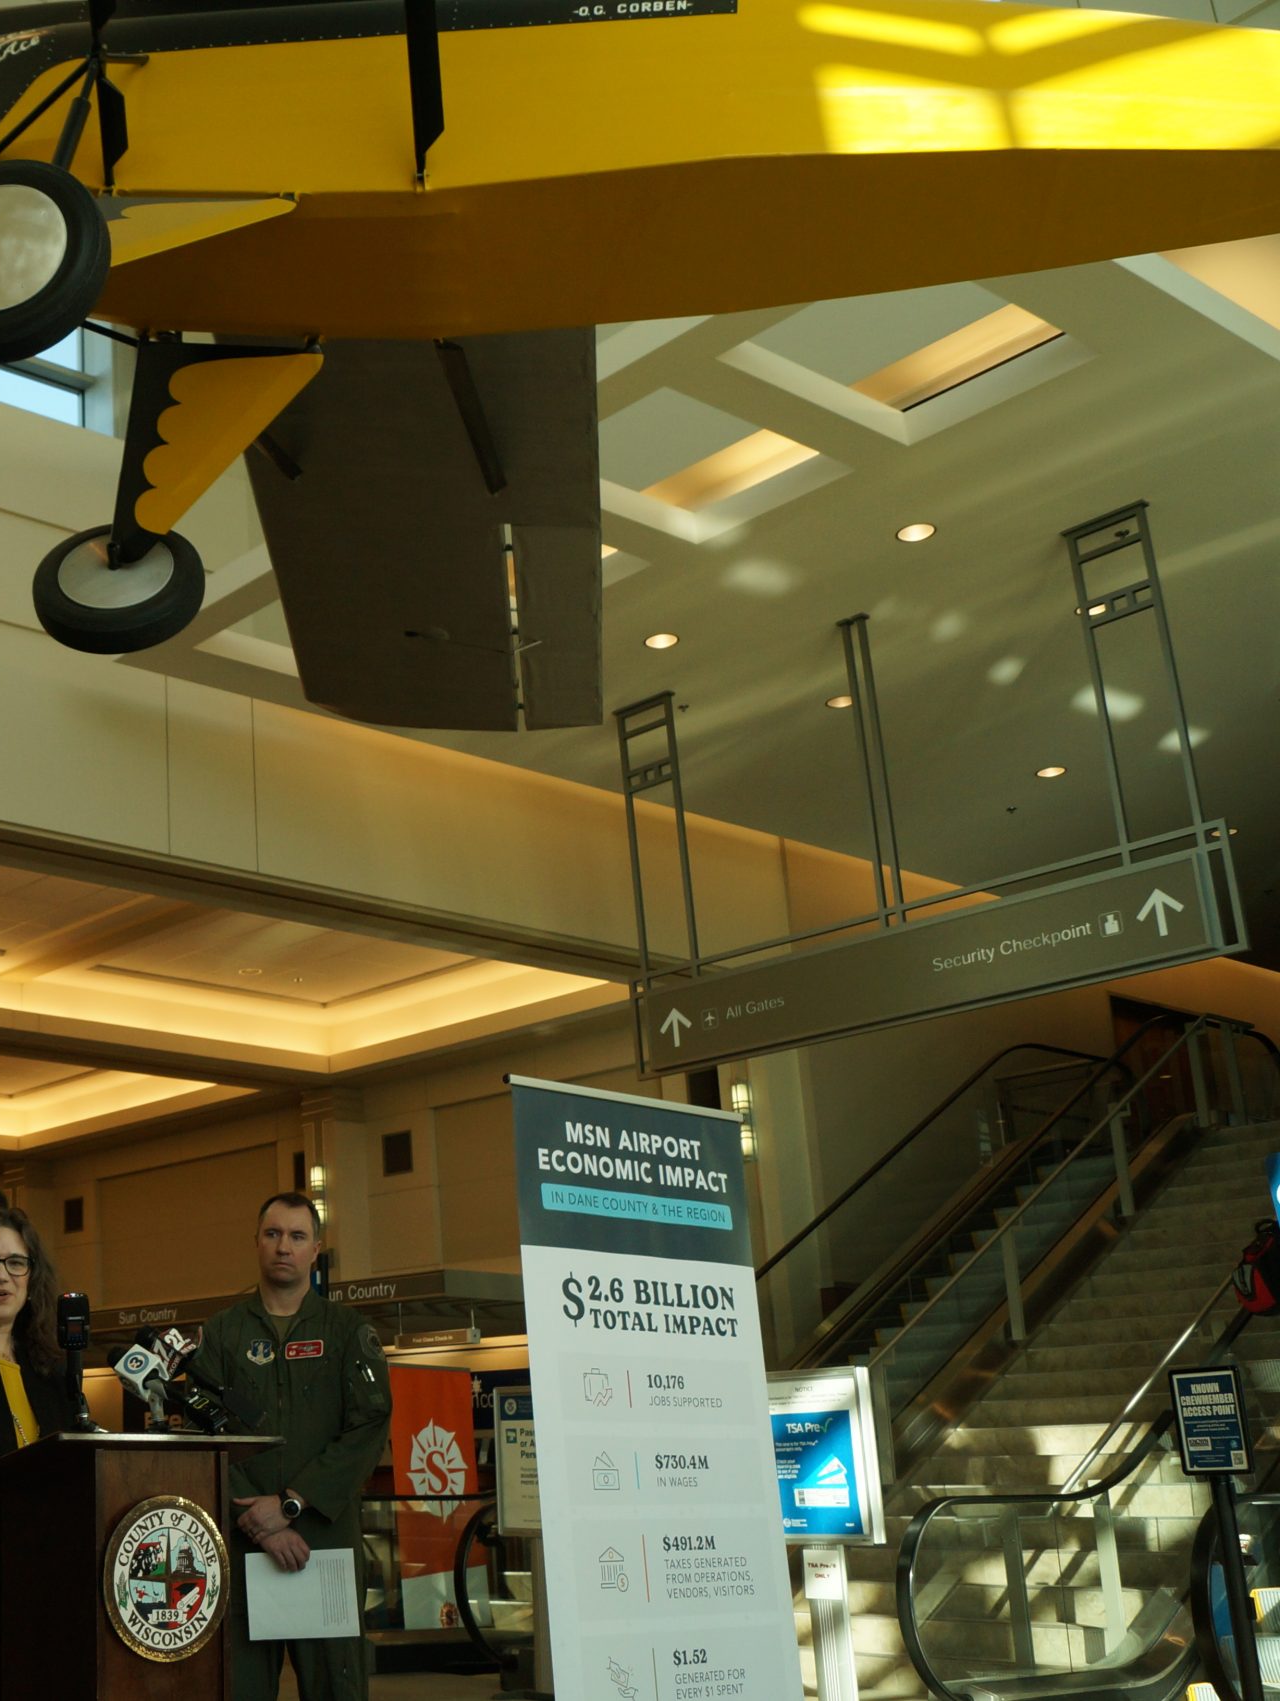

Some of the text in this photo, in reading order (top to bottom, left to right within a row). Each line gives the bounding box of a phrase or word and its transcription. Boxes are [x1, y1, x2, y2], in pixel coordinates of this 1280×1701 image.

[932, 922, 1092, 972] Security Checkpoint
[726, 996, 785, 1020] All Gates
[565, 1121, 700, 1161] MSN AIRPORT
[537, 1147, 727, 1193] ECONOMIC IMPACT
[551, 1190, 726, 1223] IN DANE COUNTY & THE REGION
[329, 1283, 396, 1301] un Country
[633, 1279, 735, 1311] BILLION
[119, 1307, 177, 1324] Sun Country
[589, 1308, 738, 1338] TOTAL IMPACT
[646, 1374, 685, 1390] 10,176
[1191, 1383, 1220, 1394] KNOWN
[649, 1395, 722, 1408] JOBS SUPPORTED
[1180, 1393, 1234, 1406] CREWMEMBER
[1183, 1404, 1235, 1417] ACCESS POINT
[786, 1423, 803, 1434] TSA
[655, 1453, 709, 1470] $730.4M
[426, 1450, 448, 1493] S
[656, 1476, 698, 1487] IN WAGES
[118, 1511, 217, 1567] COUNTY of DANE
[662, 1535, 716, 1552] $491.2M
[664, 1556, 747, 1569] TAXES GENERATED
[665, 1570, 754, 1584] FROM OPERATIONS,
[666, 1584, 755, 1600] VENDORS, VISITORS
[155, 1610, 179, 1621] 1839
[127, 1610, 208, 1647] WISCONSIN
[672, 1649, 708, 1666] $1.52
[675, 1668, 746, 1684] GENERATED FOR
[675, 1683, 744, 1700] EVERY $1 SPENT
